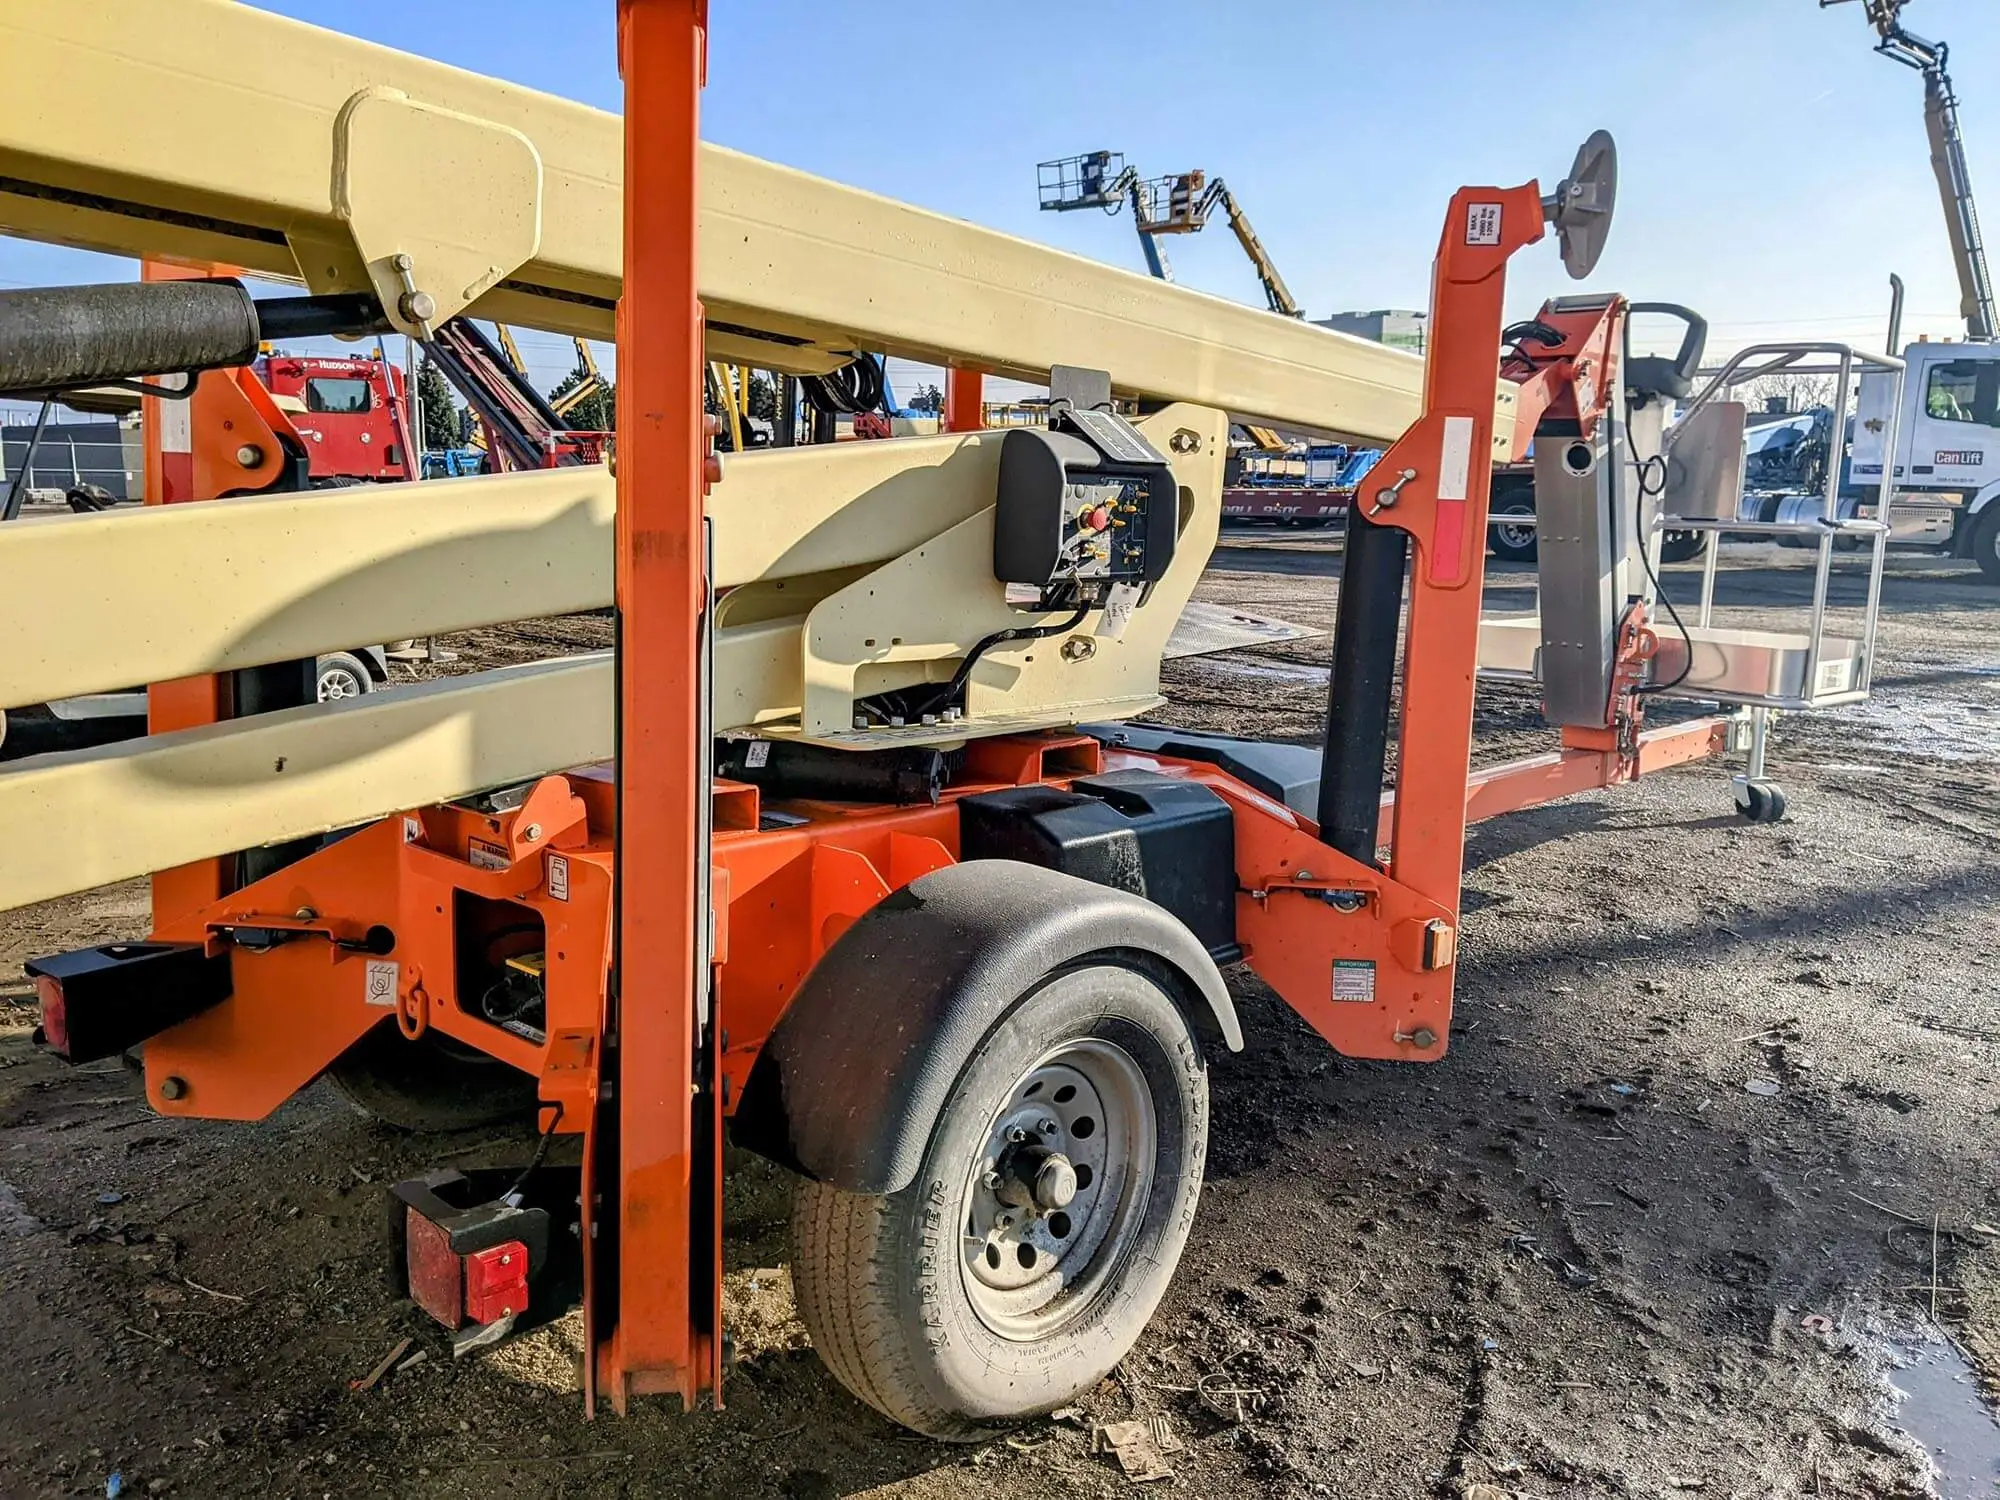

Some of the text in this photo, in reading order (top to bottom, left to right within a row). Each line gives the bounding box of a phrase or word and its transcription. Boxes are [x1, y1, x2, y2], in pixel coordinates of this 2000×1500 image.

[319, 359, 356, 370] HUDSON
[1936, 451, 1981, 465] CanLift
[920, 1178, 951, 1356] KARRIER
